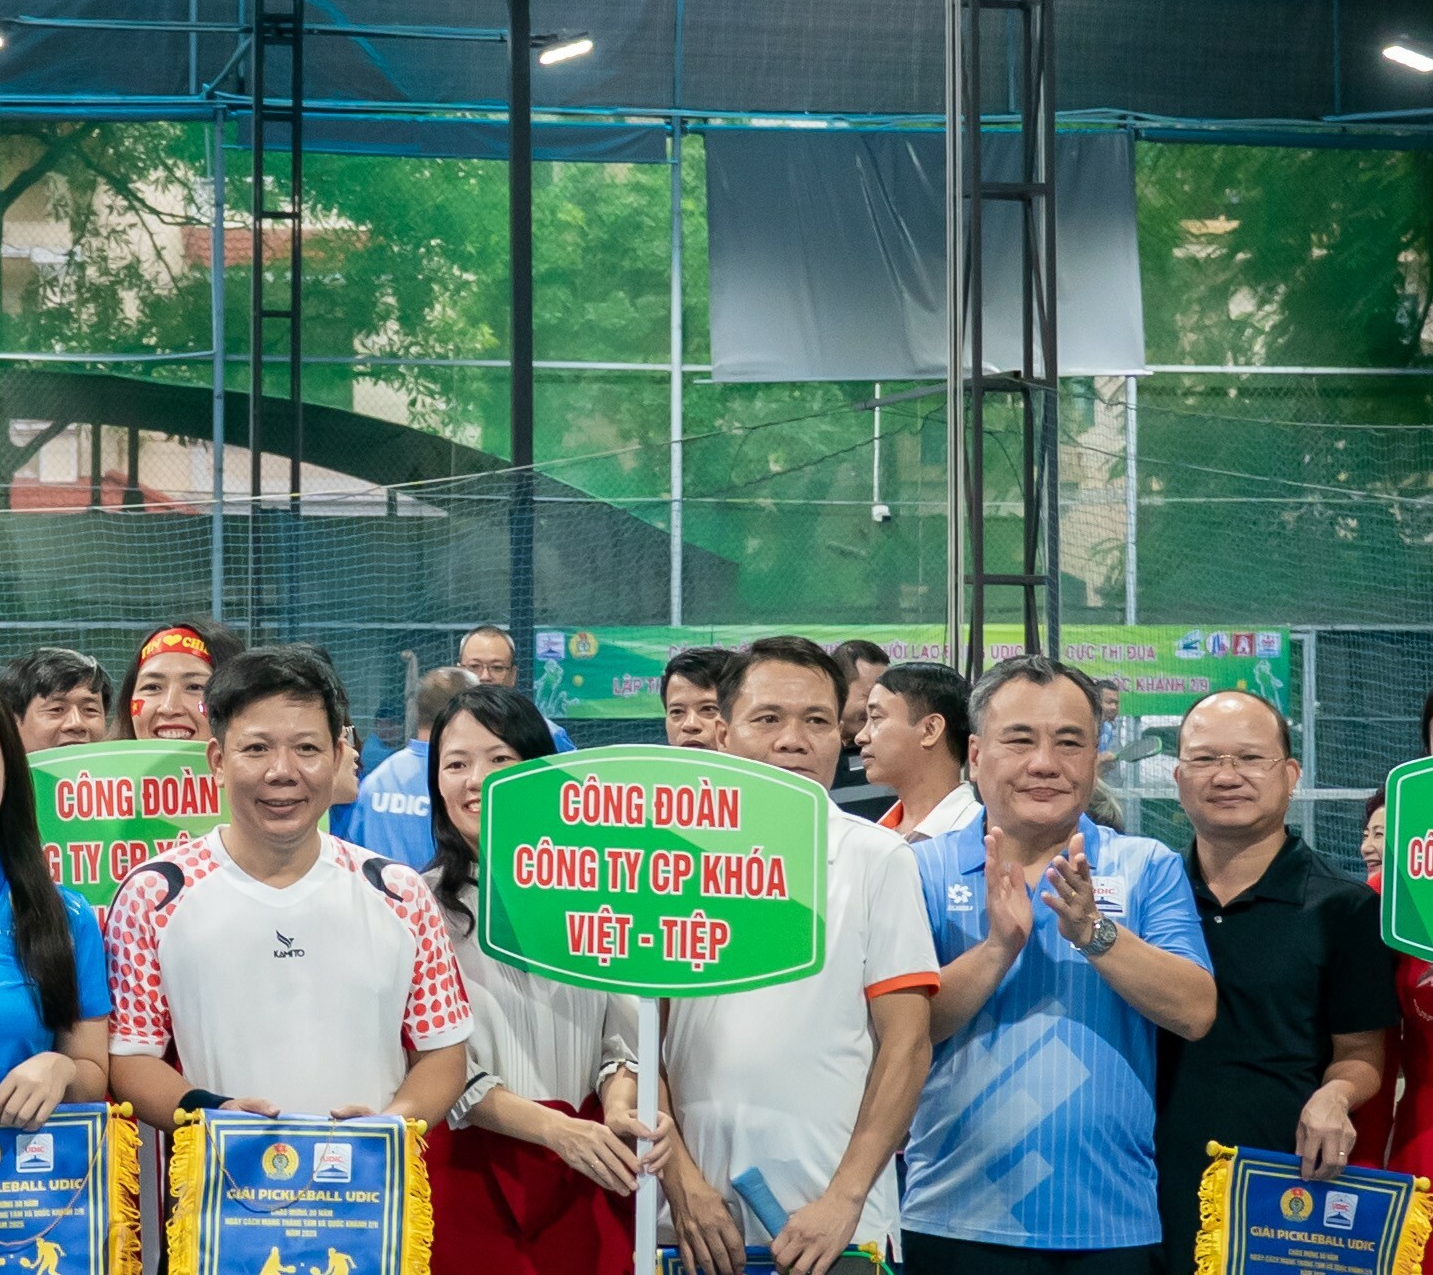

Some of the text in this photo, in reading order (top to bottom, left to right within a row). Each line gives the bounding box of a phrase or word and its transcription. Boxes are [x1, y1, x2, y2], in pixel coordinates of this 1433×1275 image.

[57, 768, 219, 819] CÔNG ĐOÀN
[371, 792, 430, 816] UDIC
[563, 776, 739, 829] CÔNG ĐOÀN
[69, 843, 102, 883] TY
[516, 839, 787, 898] CÔNG TY CP KHÓA
[273, 949, 305, 958] KAMITO
[567, 907, 631, 964] VIỆT
[661, 912, 729, 969] TIỆP
[49, 1178, 84, 1190] UDIC
[226, 1186, 381, 1203] GIẢI PICKLEBALL UDIC
[1250, 1225, 1375, 1252] GIẢI PICKLEBALL UDIC
